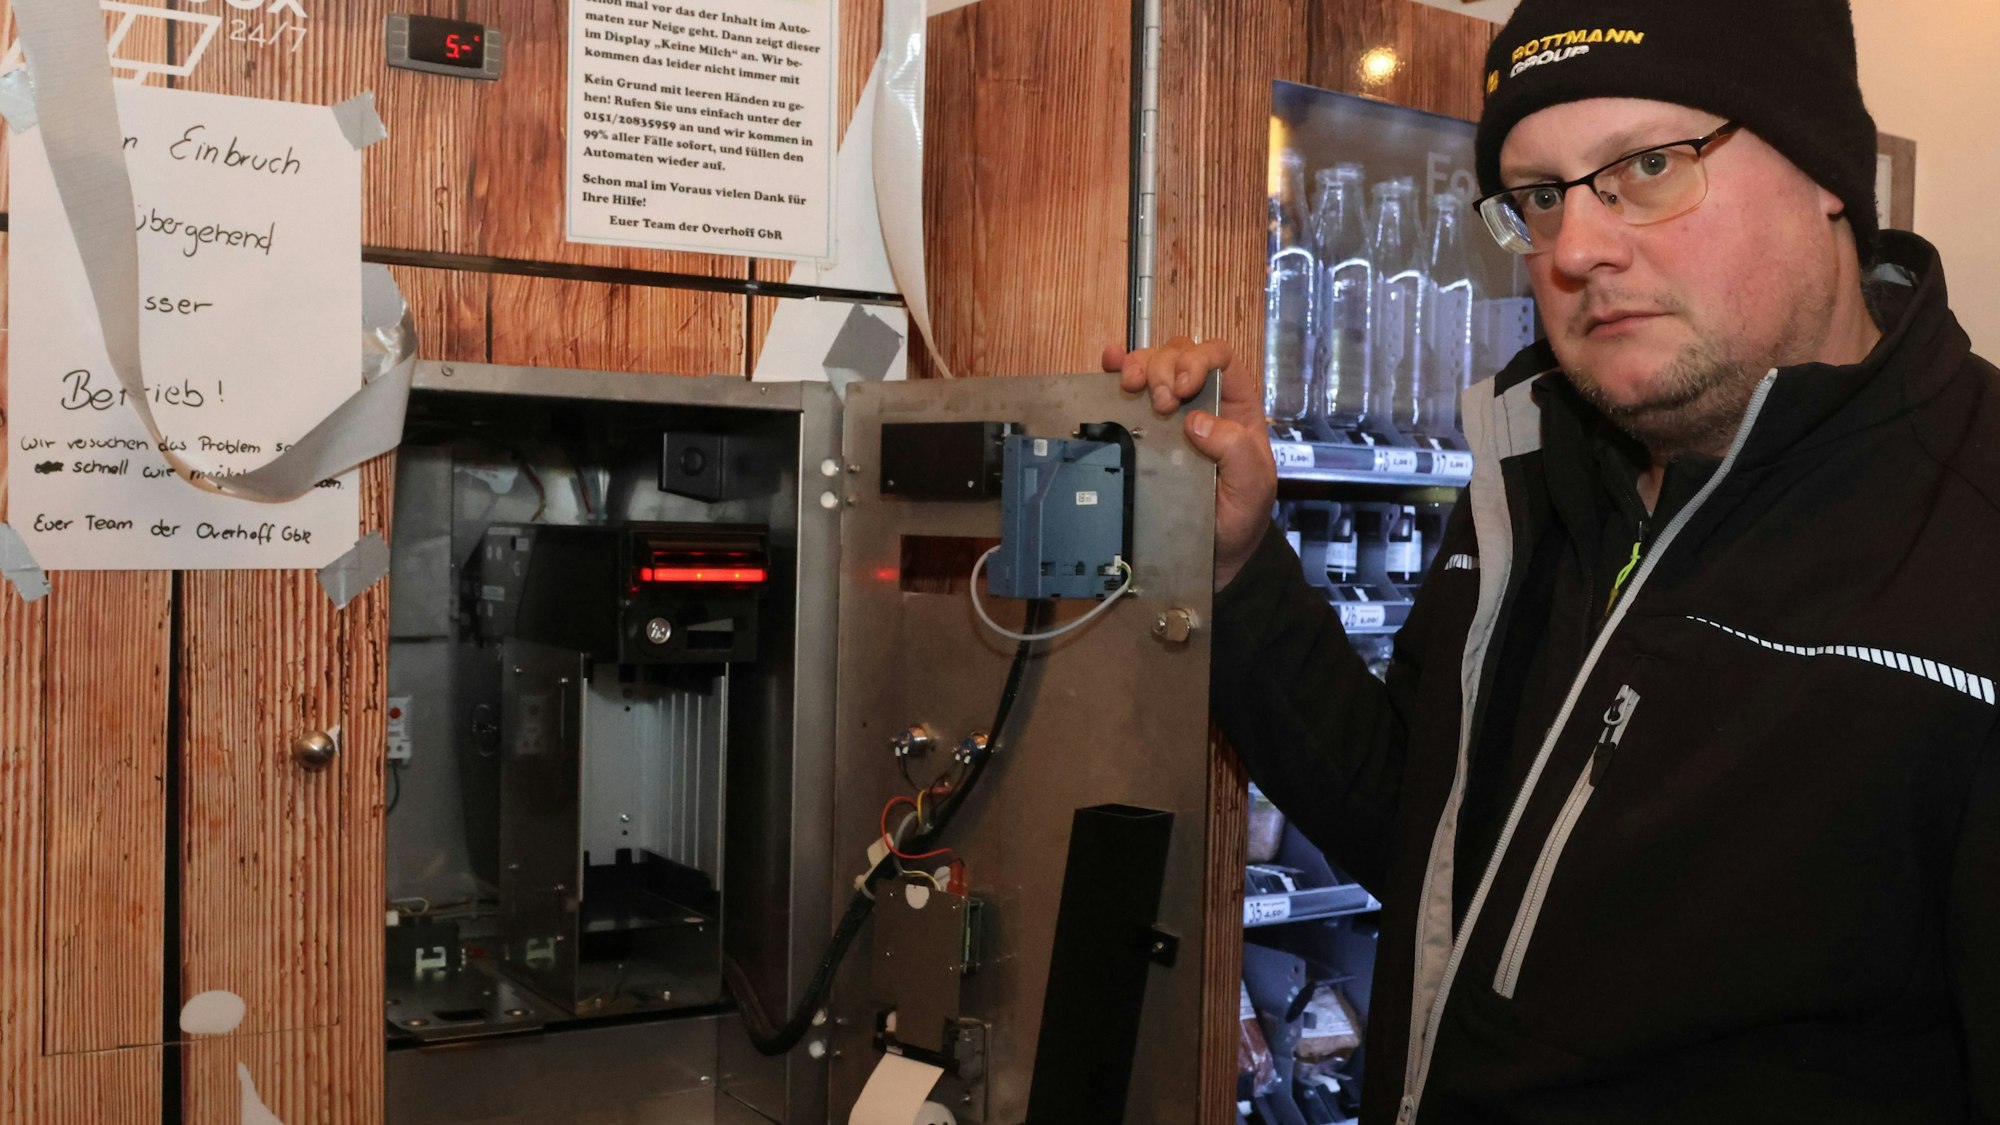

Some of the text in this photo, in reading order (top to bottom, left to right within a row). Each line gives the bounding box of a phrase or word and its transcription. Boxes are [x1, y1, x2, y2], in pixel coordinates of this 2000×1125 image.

[625, 0, 648, 10] mal
[652, 4, 672, 14] vor
[675, 6, 695, 17] das
[698, 9, 719, 21] der
[722, 12, 758, 27] Inhalt
[760, 18, 776, 30] im
[230, 19, 307, 52] 24/7
[585, 12, 624, 25] maten
[628, 18, 649, 28] zur
[652, 19, 686, 35] Neige
[722, 30, 753, 44] Dann
[756, 37, 783, 49] zeigt
[786, 40, 821, 54] dieser
[585, 28, 601, 40] im
[604, 30, 651, 48] Display
[761, 53, 784, 65] Wir
[1512, 28, 1645, 64] ROTTMANN
[584, 46, 800, 85] kommen das leider nicht immer mit
[1510, 45, 1590, 78] GROUP
[584, 73, 613, 87] Kein
[616, 78, 657, 92] Grund
[660, 85, 682, 95] mit
[685, 86, 722, 101] leeren
[725, 91, 769, 107] Händen
[772, 100, 786, 109] zu
[584, 91, 802, 128] hen! Rufen Sie uns einfach unter der
[583, 111, 813, 147] 0151/20835959 an und wir kommen in
[169, 125, 300, 174] Einbruch
[583, 129, 804, 163] 99% aller Fälle sofort, und füllen den
[583, 146, 654, 164] Automaten
[656, 155, 700, 168] wieder
[582, 173, 807, 205] Schon mal im Voraus vielen Dank für
[1426, 152, 1480, 201] Fo
[582, 191, 646, 207] Ihre Hilfe!
[610, 215, 783, 240] Euer Team der Overhoff GbR
[144, 296, 213, 315] sser
[158, 435, 187, 453] das
[198, 435, 262, 454] Problem
[142, 465, 176, 479] wie
[33, 513, 75, 533] Euer
[84, 514, 134, 531] Team
[150, 518, 181, 538] der
[196, 522, 276, 546] Overhoff
